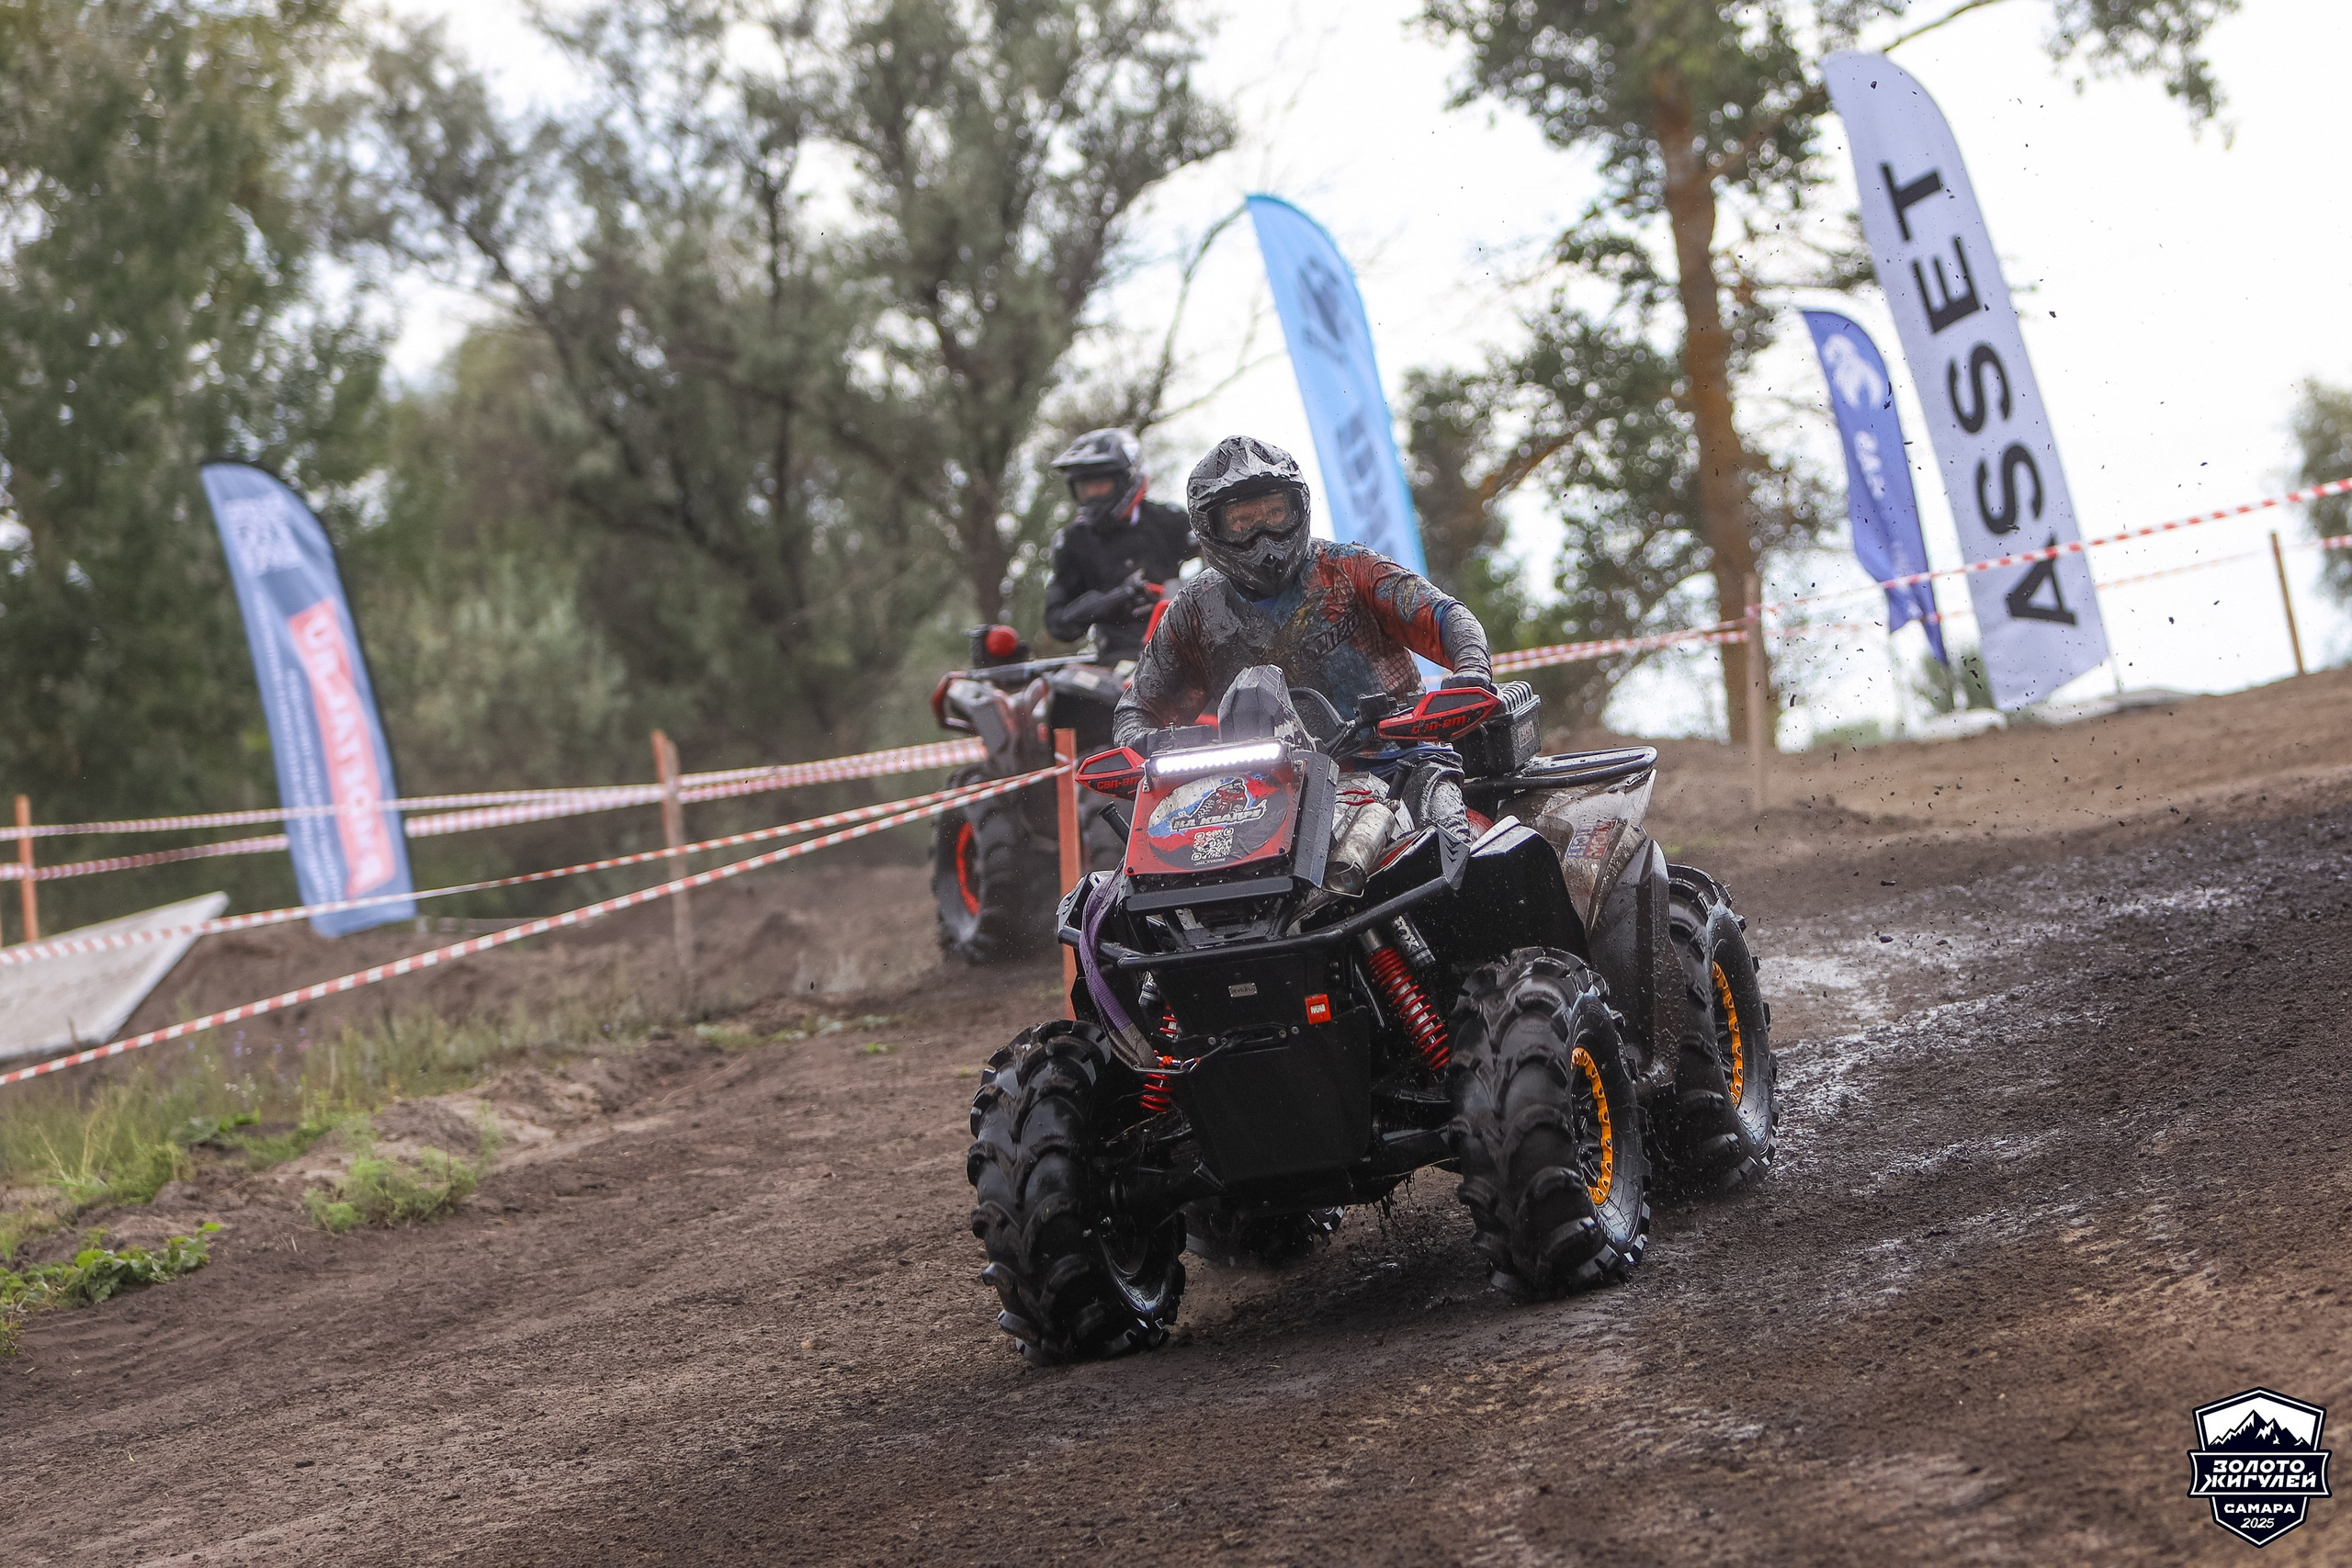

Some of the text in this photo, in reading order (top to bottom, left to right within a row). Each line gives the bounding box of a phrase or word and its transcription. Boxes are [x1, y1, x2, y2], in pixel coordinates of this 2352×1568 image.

[1880, 161, 2078, 626] ASSET
[1097, 776, 1142, 790] can-am
[1391, 915, 1420, 953] FOX
